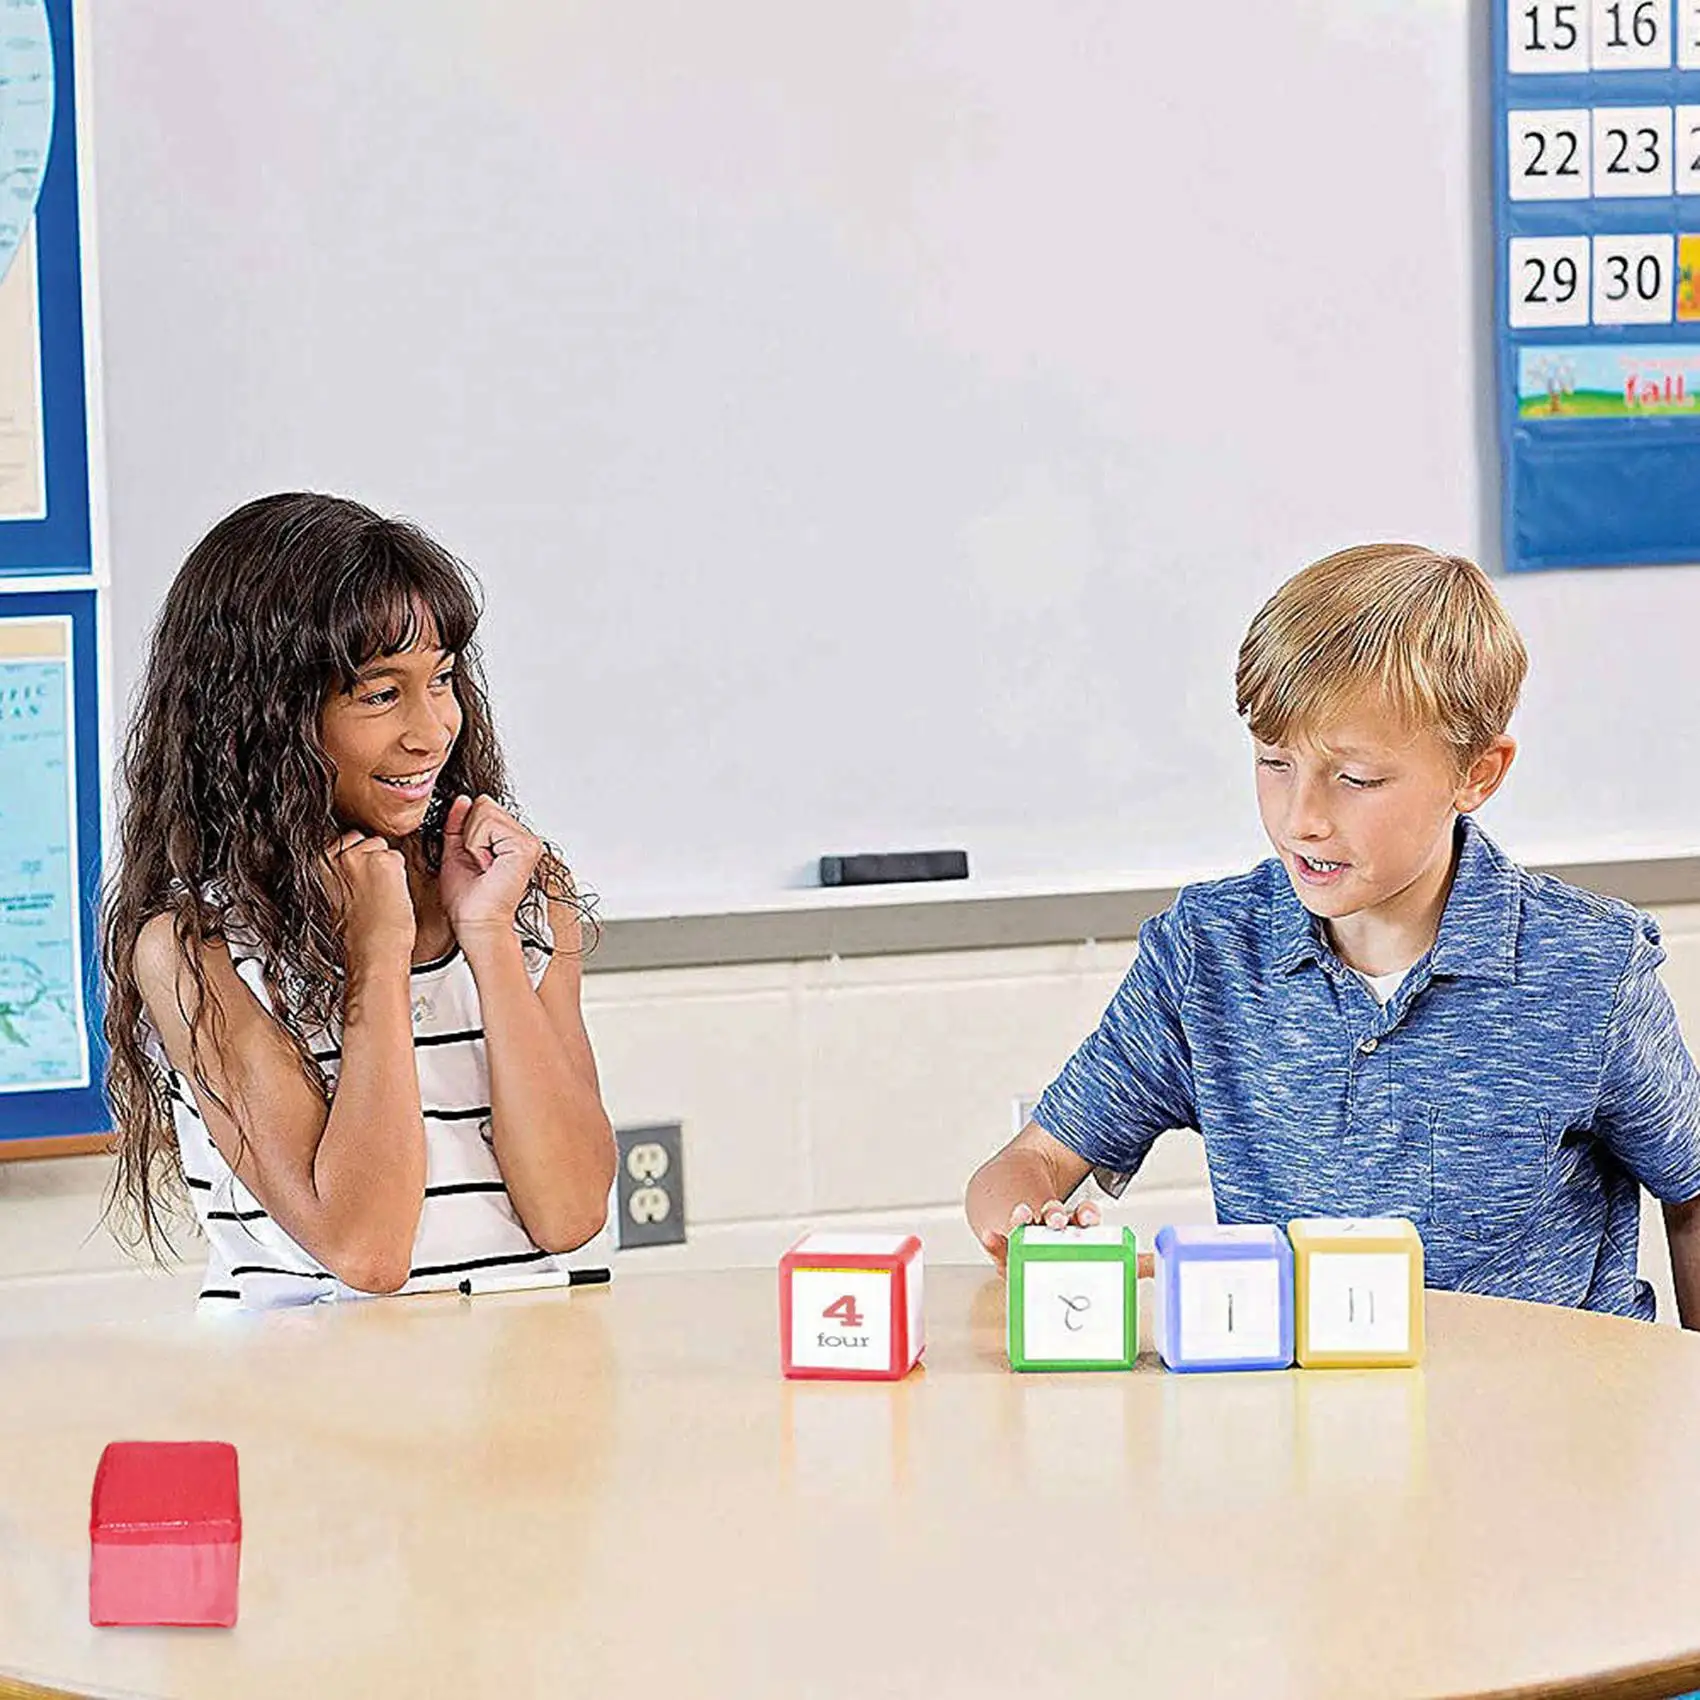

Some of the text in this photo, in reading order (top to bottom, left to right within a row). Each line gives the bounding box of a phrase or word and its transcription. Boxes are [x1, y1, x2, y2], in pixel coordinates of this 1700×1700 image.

[1524, 6, 1577, 51] 15
[1606, 1, 1657, 47] 16
[1523, 131, 1580, 177] 22
[1606, 128, 1660, 174] 23
[1523, 255, 1661, 303] 29 30
[822, 1295, 864, 1327] 4
[817, 1332, 870, 1348] four
